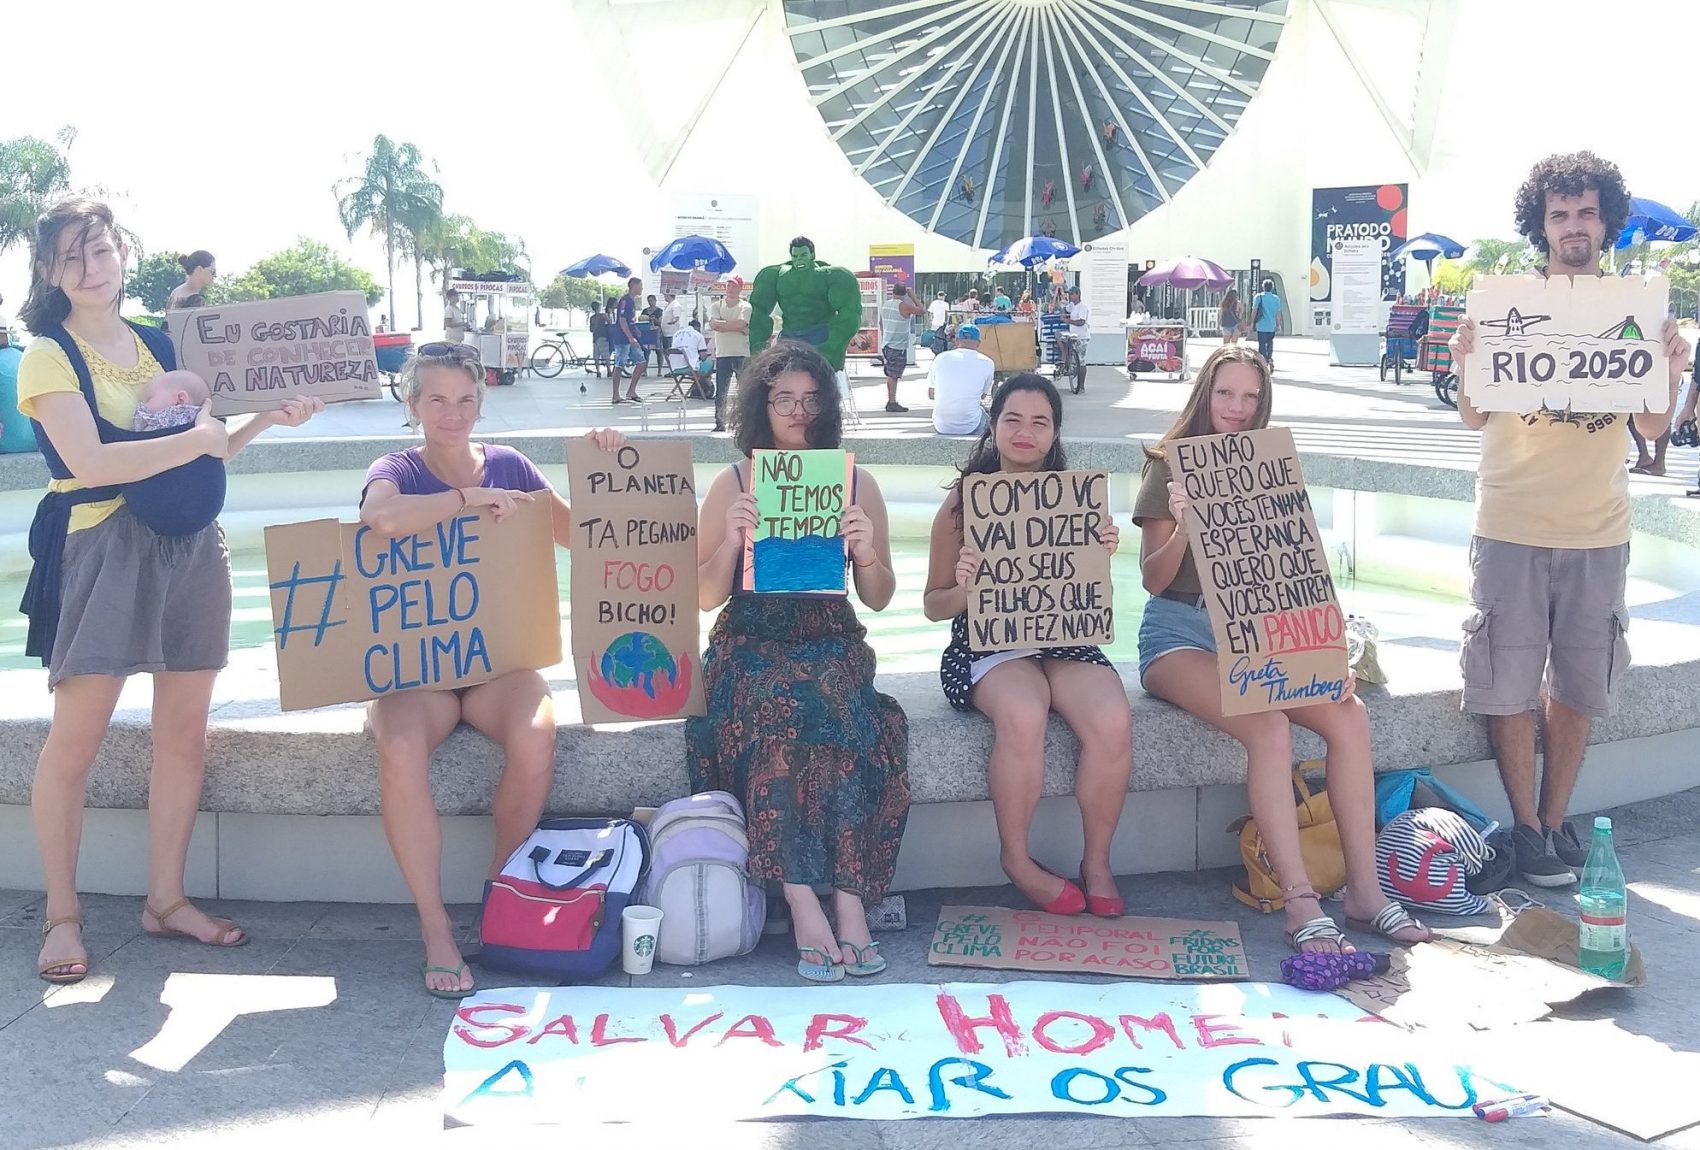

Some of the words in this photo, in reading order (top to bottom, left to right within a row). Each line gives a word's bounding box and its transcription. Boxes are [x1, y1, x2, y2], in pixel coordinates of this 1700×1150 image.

[1327, 222, 1391, 237] PRATODO
[480, 284, 503, 292] PIPOCAS
[208, 350, 236, 367] DE
[247, 337, 373, 365] CONHECER
[1492, 351, 1556, 384] RIO
[1569, 349, 1653, 379] 2050
[214, 371, 236, 393] A
[246, 359, 378, 391] NATUREZA
[617, 446, 640, 470] O
[761, 451, 803, 483] NÃO
[1177, 444, 1207, 473] EU
[1211, 432, 1255, 467] NÃO
[587, 472, 696, 495] PLANETA
[1185, 464, 1254, 501] QUERO
[1258, 457, 1298, 490] QUE
[776, 483, 844, 513] TEMOS
[970, 473, 1063, 519] COMO
[1072, 474, 1105, 510] VC
[1192, 494, 1255, 530] VOCÊS
[1251, 489, 1312, 522] TENHAM
[355, 515, 480, 578] GREVE
[579, 518, 620, 549] TA
[626, 519, 696, 547] PEGANDO
[970, 520, 1016, 553] VAI
[1026, 511, 1105, 548] DIZER
[1200, 517, 1313, 559] ESPERANÇA
[603, 560, 675, 593] FOGO
[975, 556, 1024, 585] AOS
[1028, 552, 1075, 581] SEUS
[1212, 552, 1275, 590] QUERO
[1280, 549, 1323, 579] QUE
[369, 571, 480, 633] PELO
[598, 600, 676, 625] BICHO!
[979, 584, 1055, 614] FILHOS
[1060, 581, 1103, 612] QUE
[1217, 580, 1276, 621] VOCÊS
[1276, 574, 1338, 611] ENTREM
[974, 617, 1000, 647] VC
[1023, 613, 1059, 641] FEZ
[1062, 607, 1113, 640] NADA?
[1226, 619, 1259, 654] EM
[1264, 604, 1342, 651] PÂNICO
[364, 627, 492, 693] CLIMA
[1229, 655, 1288, 696] Greta
[937, 921, 1001, 934] GREVE
[943, 933, 1002, 945] PELO
[1018, 923, 1165, 940] TEMPORAL
[1170, 936, 1240, 947] FRIDAYS
[933, 942, 1002, 957] CLIMA
[1015, 949, 1076, 962] POR
[1081, 954, 1171, 971] ACASO
[1018, 935, 1088, 949] NÃO
[1102, 941, 1160, 956] FOI
[1172, 953, 1242, 966] FUTURE
[1187, 945, 1223, 954] FOR
[1174, 964, 1246, 976] BRASIL
[454, 1003, 877, 1052] SALVAR
[1051, 1064, 1167, 1107] OS
